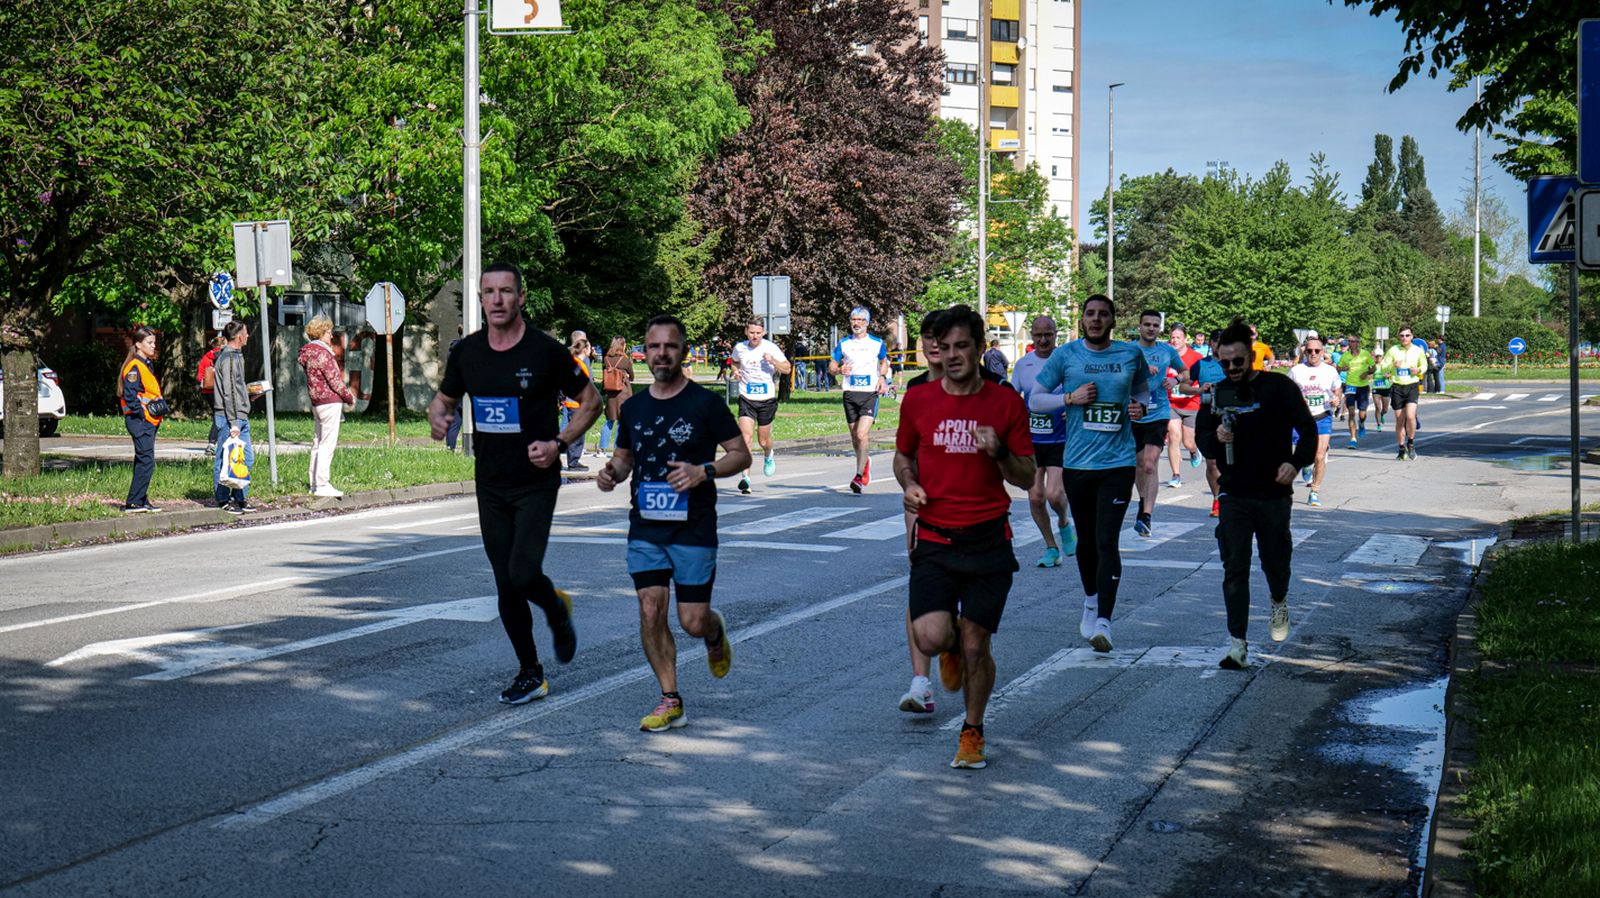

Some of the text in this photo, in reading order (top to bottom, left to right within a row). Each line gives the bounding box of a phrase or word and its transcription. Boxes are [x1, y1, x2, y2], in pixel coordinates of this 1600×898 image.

[853, 378, 868, 386] 356
[750, 386, 764, 394] 238
[484, 407, 506, 423] 25
[1086, 408, 1121, 423] 1137
[1029, 417, 1052, 428] 1234
[645, 492, 679, 510] 507
